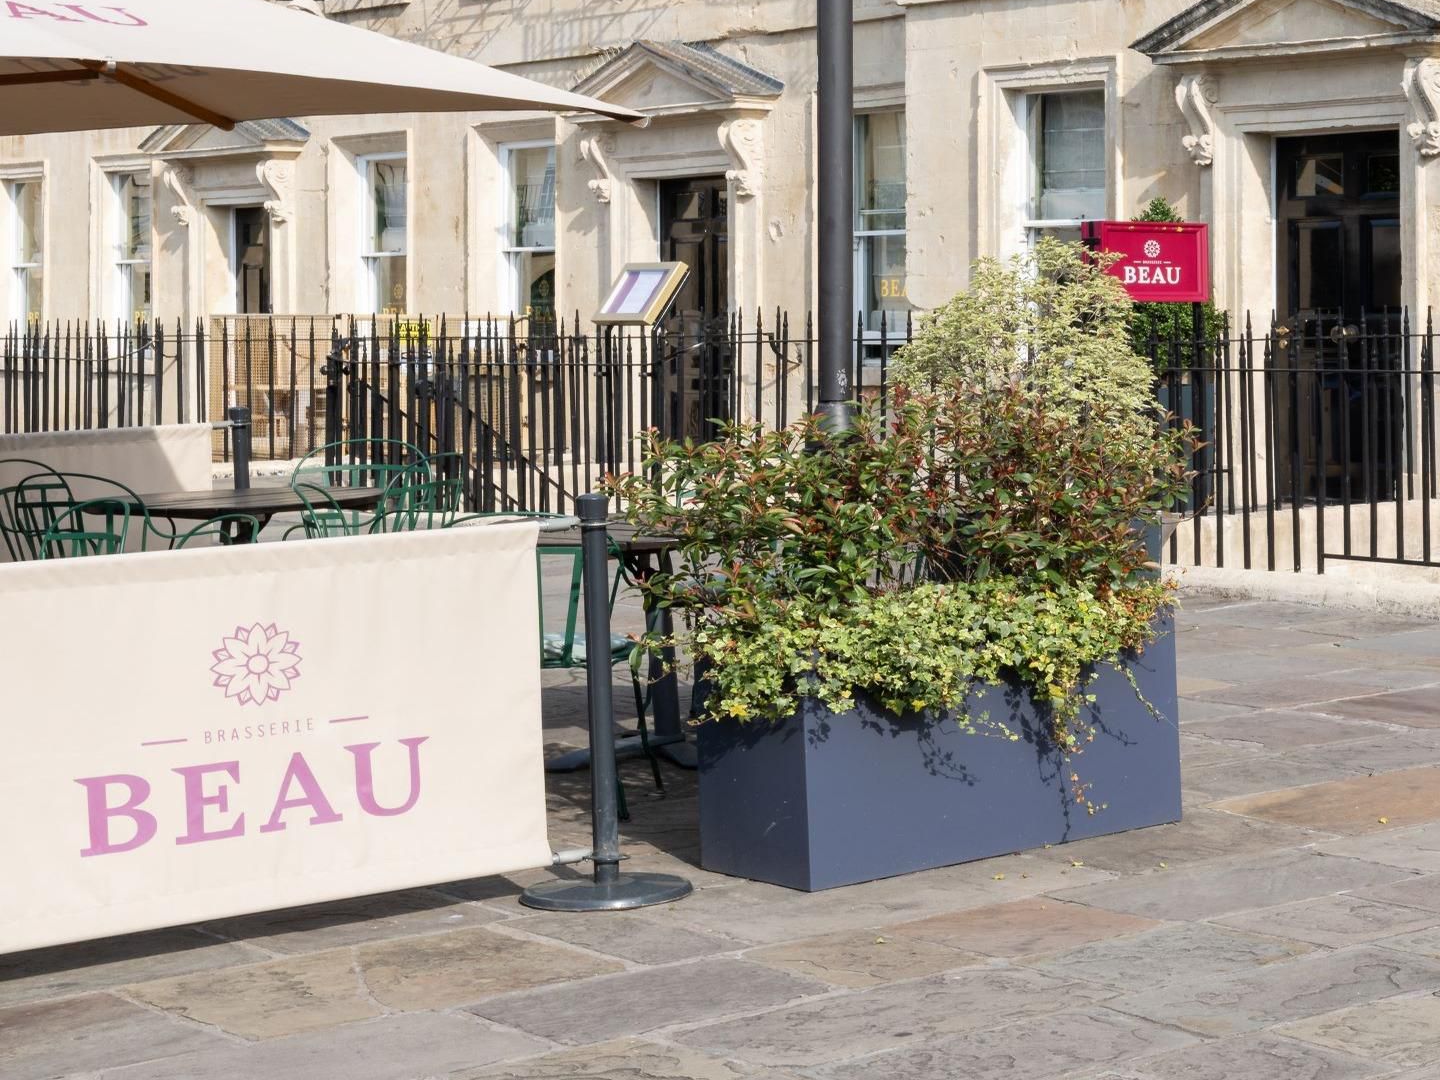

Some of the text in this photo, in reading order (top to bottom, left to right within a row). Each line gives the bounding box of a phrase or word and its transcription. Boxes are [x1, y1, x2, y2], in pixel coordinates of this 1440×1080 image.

[1123, 265, 1182, 285] BEAU
[203, 717, 315, 745] BRASSERIE
[72, 735, 431, 858] BEAU
